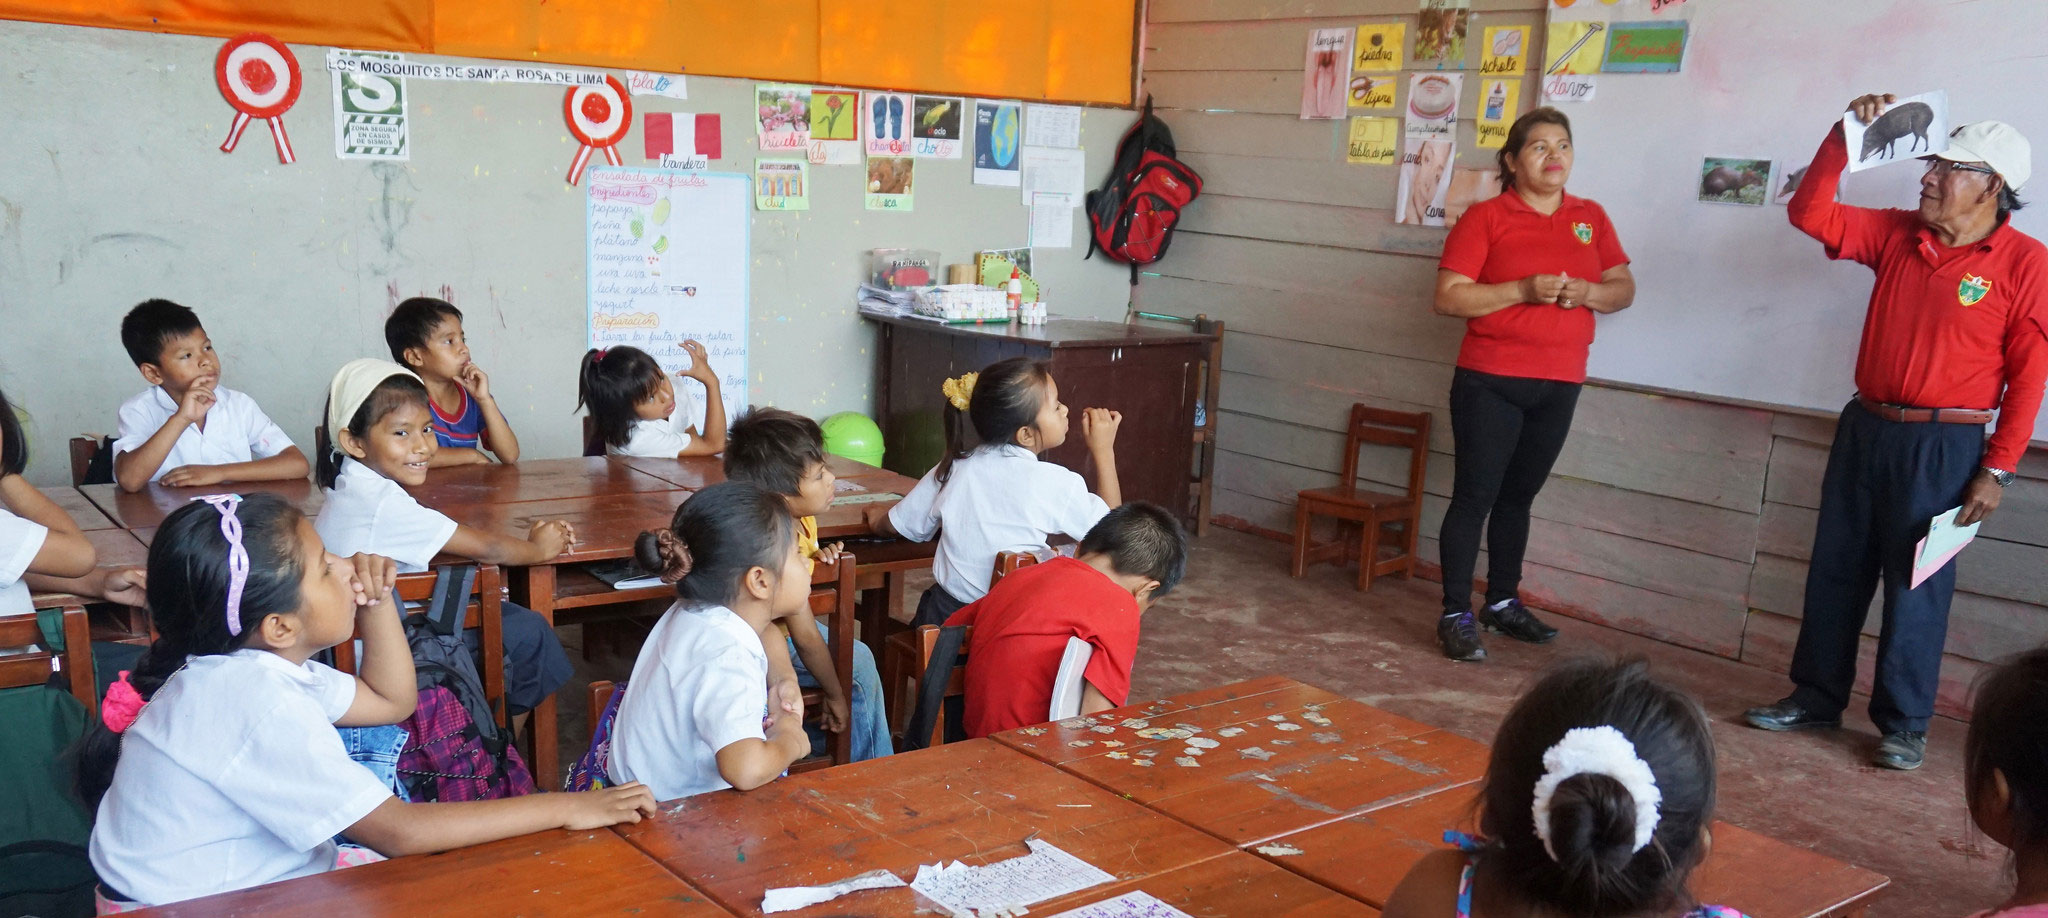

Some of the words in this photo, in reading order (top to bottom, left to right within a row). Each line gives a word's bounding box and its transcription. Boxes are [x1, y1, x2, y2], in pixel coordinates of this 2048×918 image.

[328, 59, 356, 72] LOS
[360, 60, 441, 78] MOSQUITOS
[445, 66, 464, 79] DE
[467, 67, 510, 81] SANTA
[516, 69, 552, 83] ROSA
[556, 71, 574, 84] DE
[576, 73, 605, 86] LIMA
[631, 75, 672, 94] plato
[1480, 125, 1506, 144] goma
[661, 152, 706, 169] bandera
